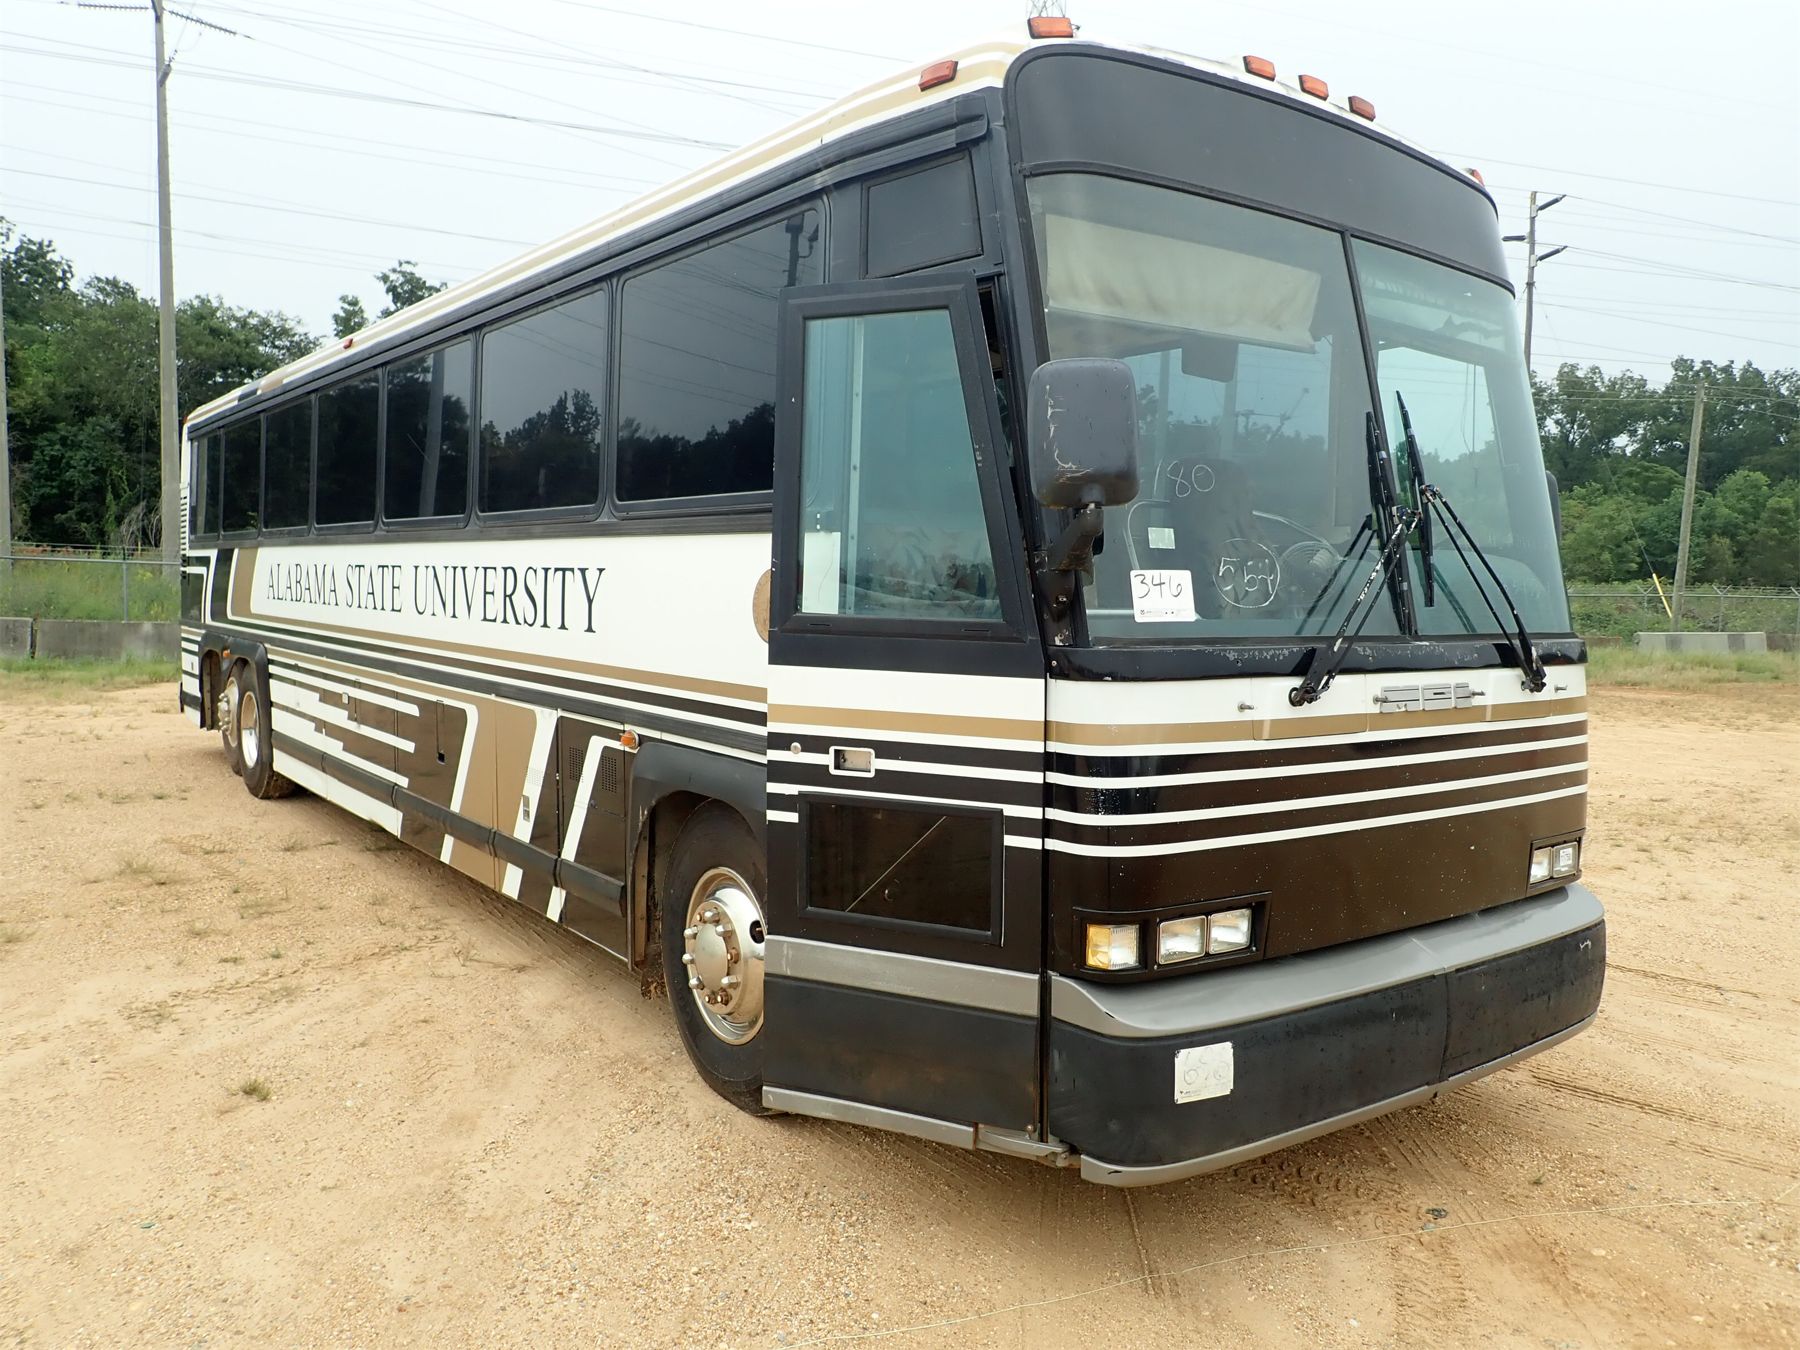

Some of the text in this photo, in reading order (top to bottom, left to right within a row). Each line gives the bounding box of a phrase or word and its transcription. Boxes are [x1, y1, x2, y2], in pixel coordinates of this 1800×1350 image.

[1153, 456, 1216, 498] 180
[266, 563, 606, 634] ALABAMA STATE UNIVERSITY
[1133, 572, 1183, 599] 346
